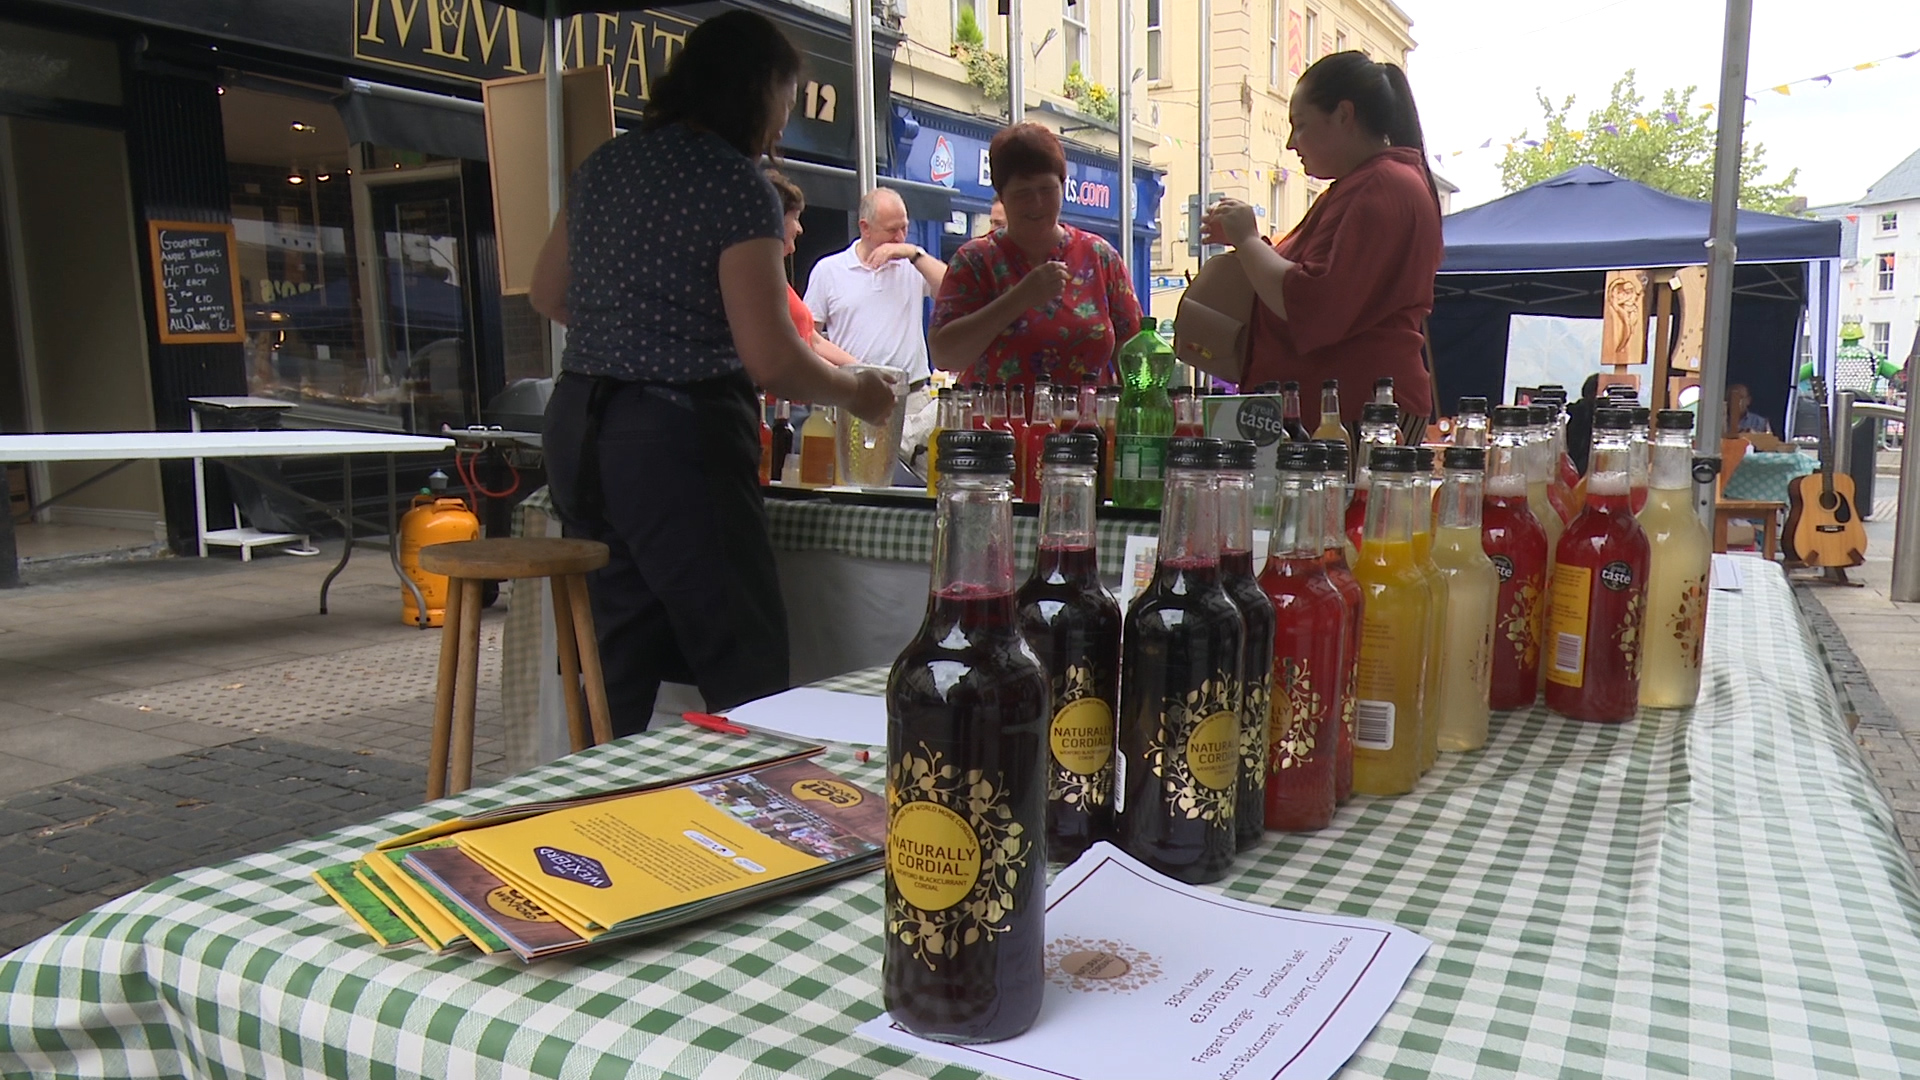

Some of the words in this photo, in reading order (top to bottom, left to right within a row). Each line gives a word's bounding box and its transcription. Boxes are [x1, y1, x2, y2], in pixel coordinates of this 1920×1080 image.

[804, 80, 837, 123] 12
[1240, 410, 1282, 434] taste
[1601, 569, 1632, 585] taste
[916, 804, 938, 813] WORLD
[938, 808, 956, 821] MORE
[893, 833, 977, 862] NATURALLY
[914, 881, 940, 892] CORDIAL
[919, 874, 968, 887] BLACKCURRANT
[1189, 967, 1214, 993] bottles
[1306, 953, 1338, 984] Cucumber
[1190, 1002, 1217, 1025] €3.50
[1208, 988, 1231, 1006] PER
[1225, 966, 1254, 991] BOTTLE
[1192, 1026, 1231, 1064] Fragrant
